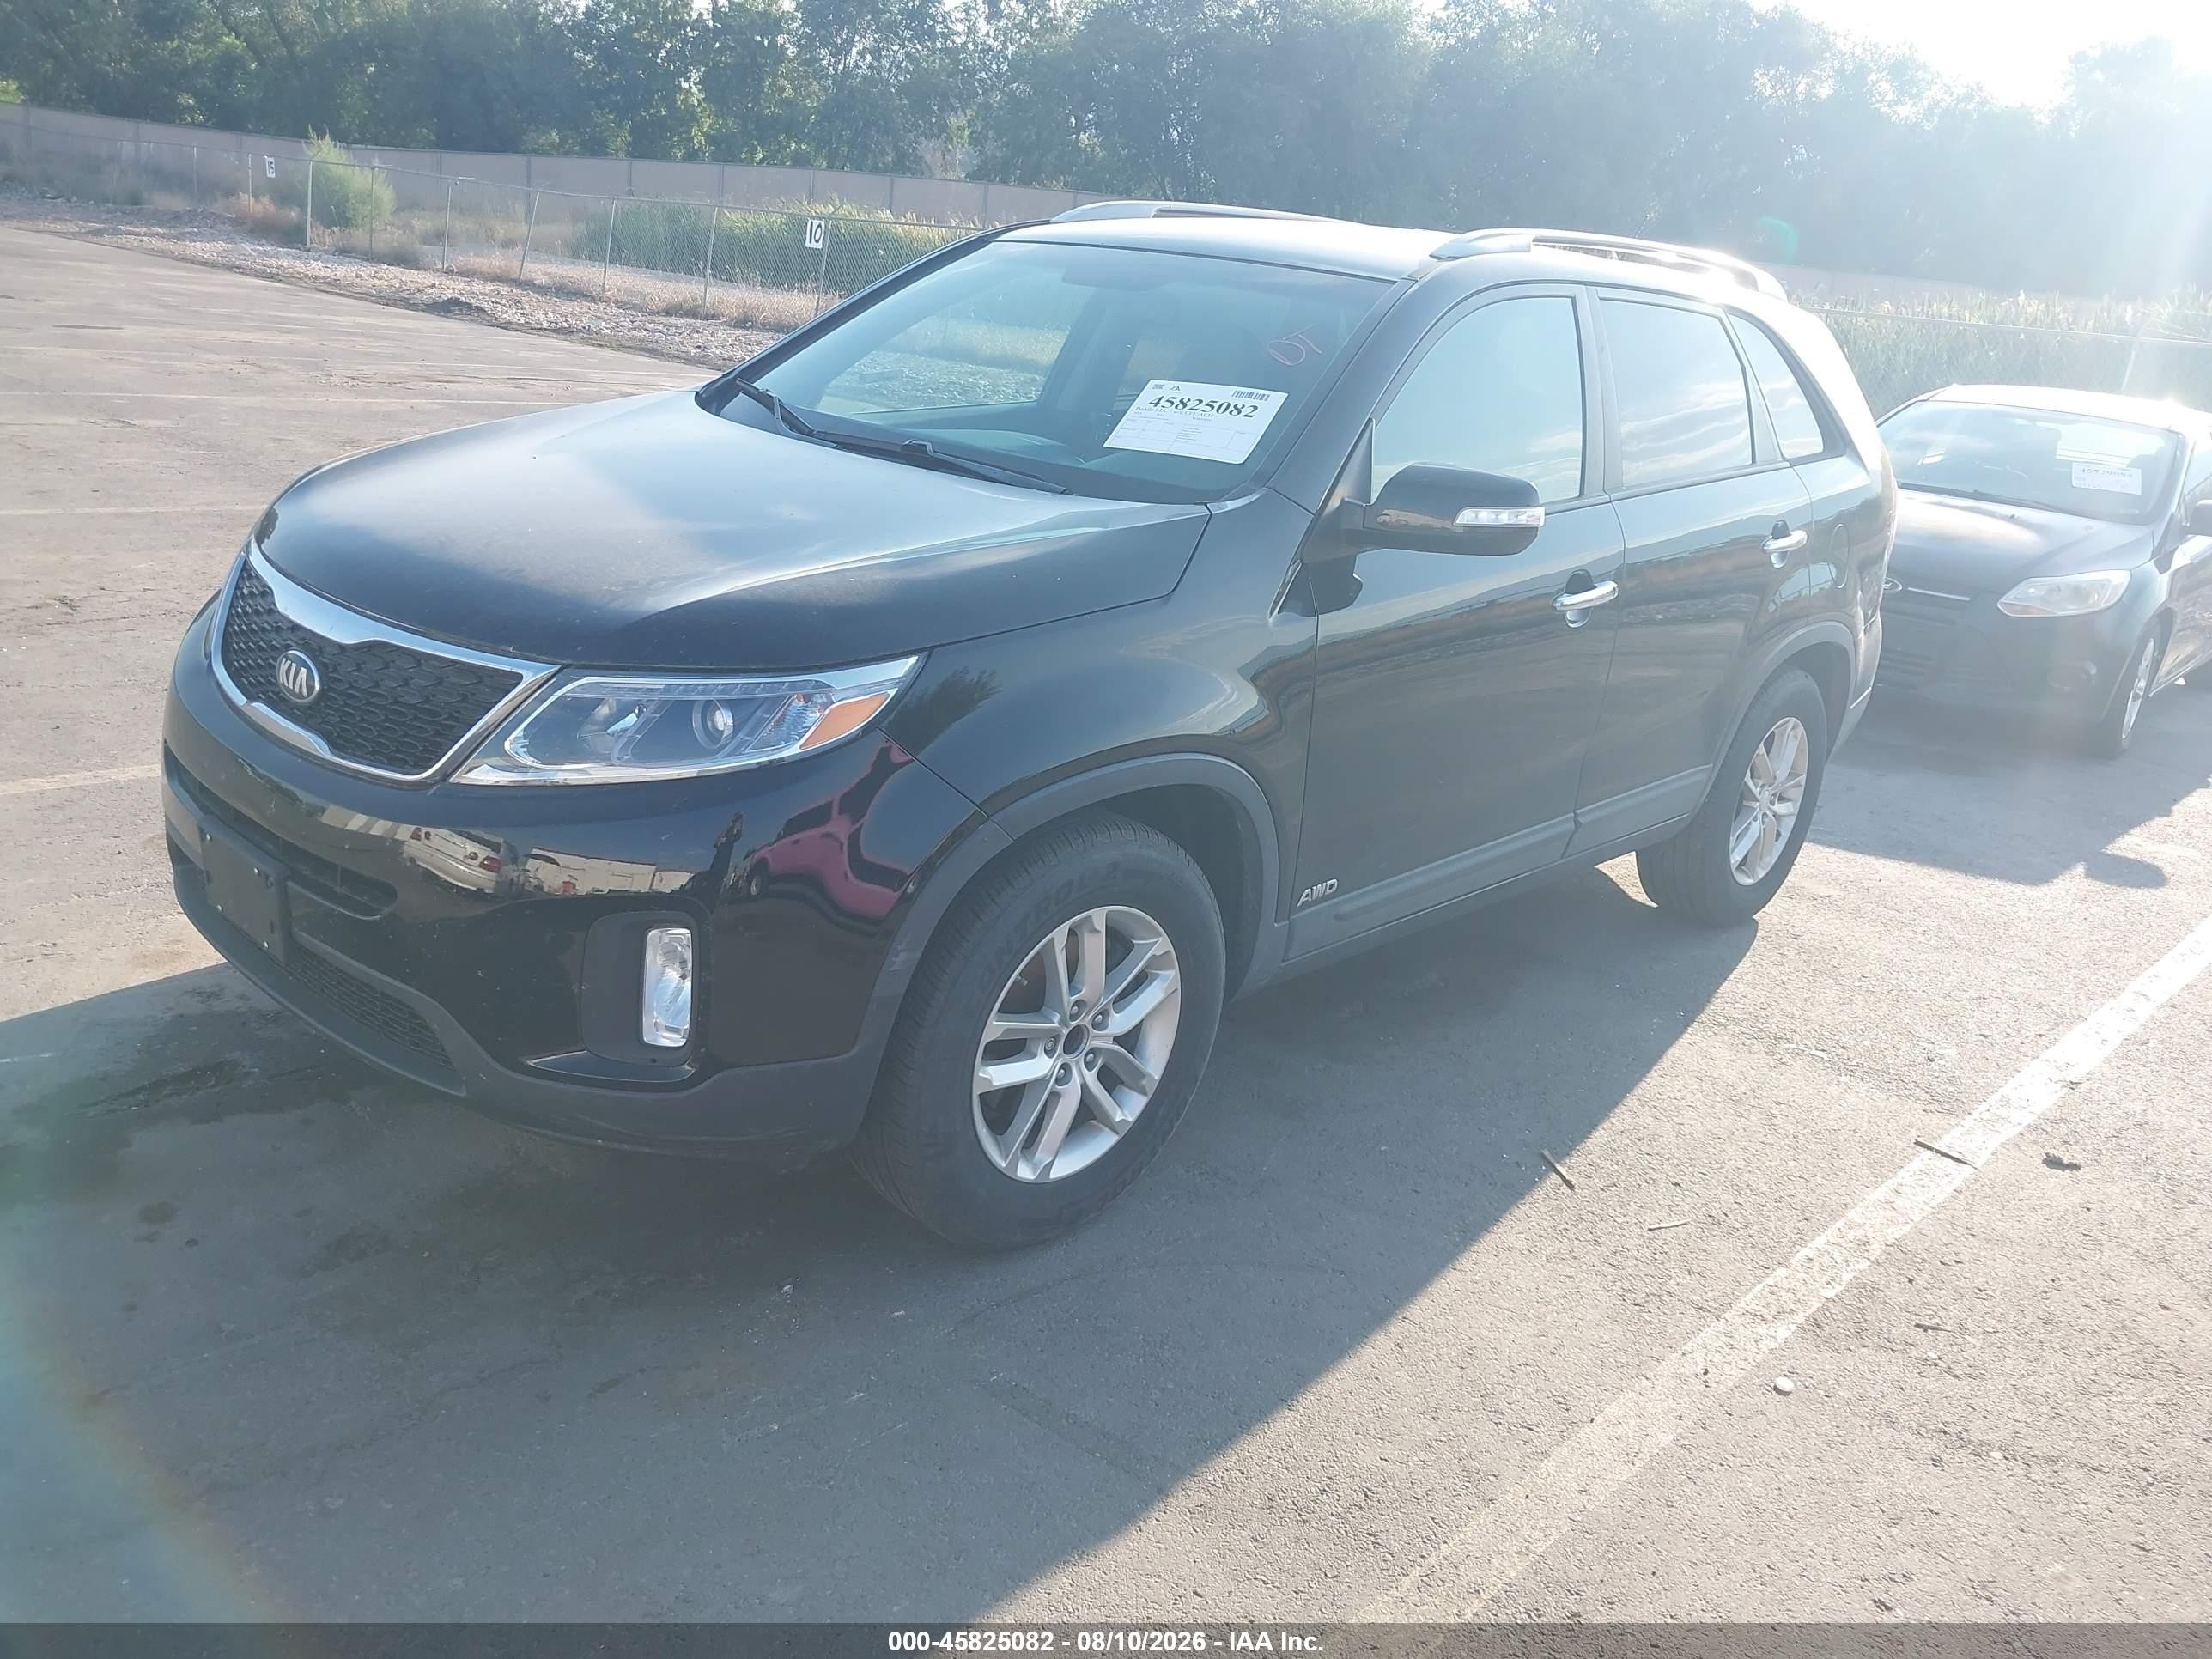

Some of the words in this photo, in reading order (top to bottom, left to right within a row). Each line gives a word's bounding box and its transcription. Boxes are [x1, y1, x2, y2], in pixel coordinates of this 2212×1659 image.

[809, 221, 823, 244] 10
[1148, 395, 1259, 418] 45825082
[1297, 878, 1338, 908] AWD
